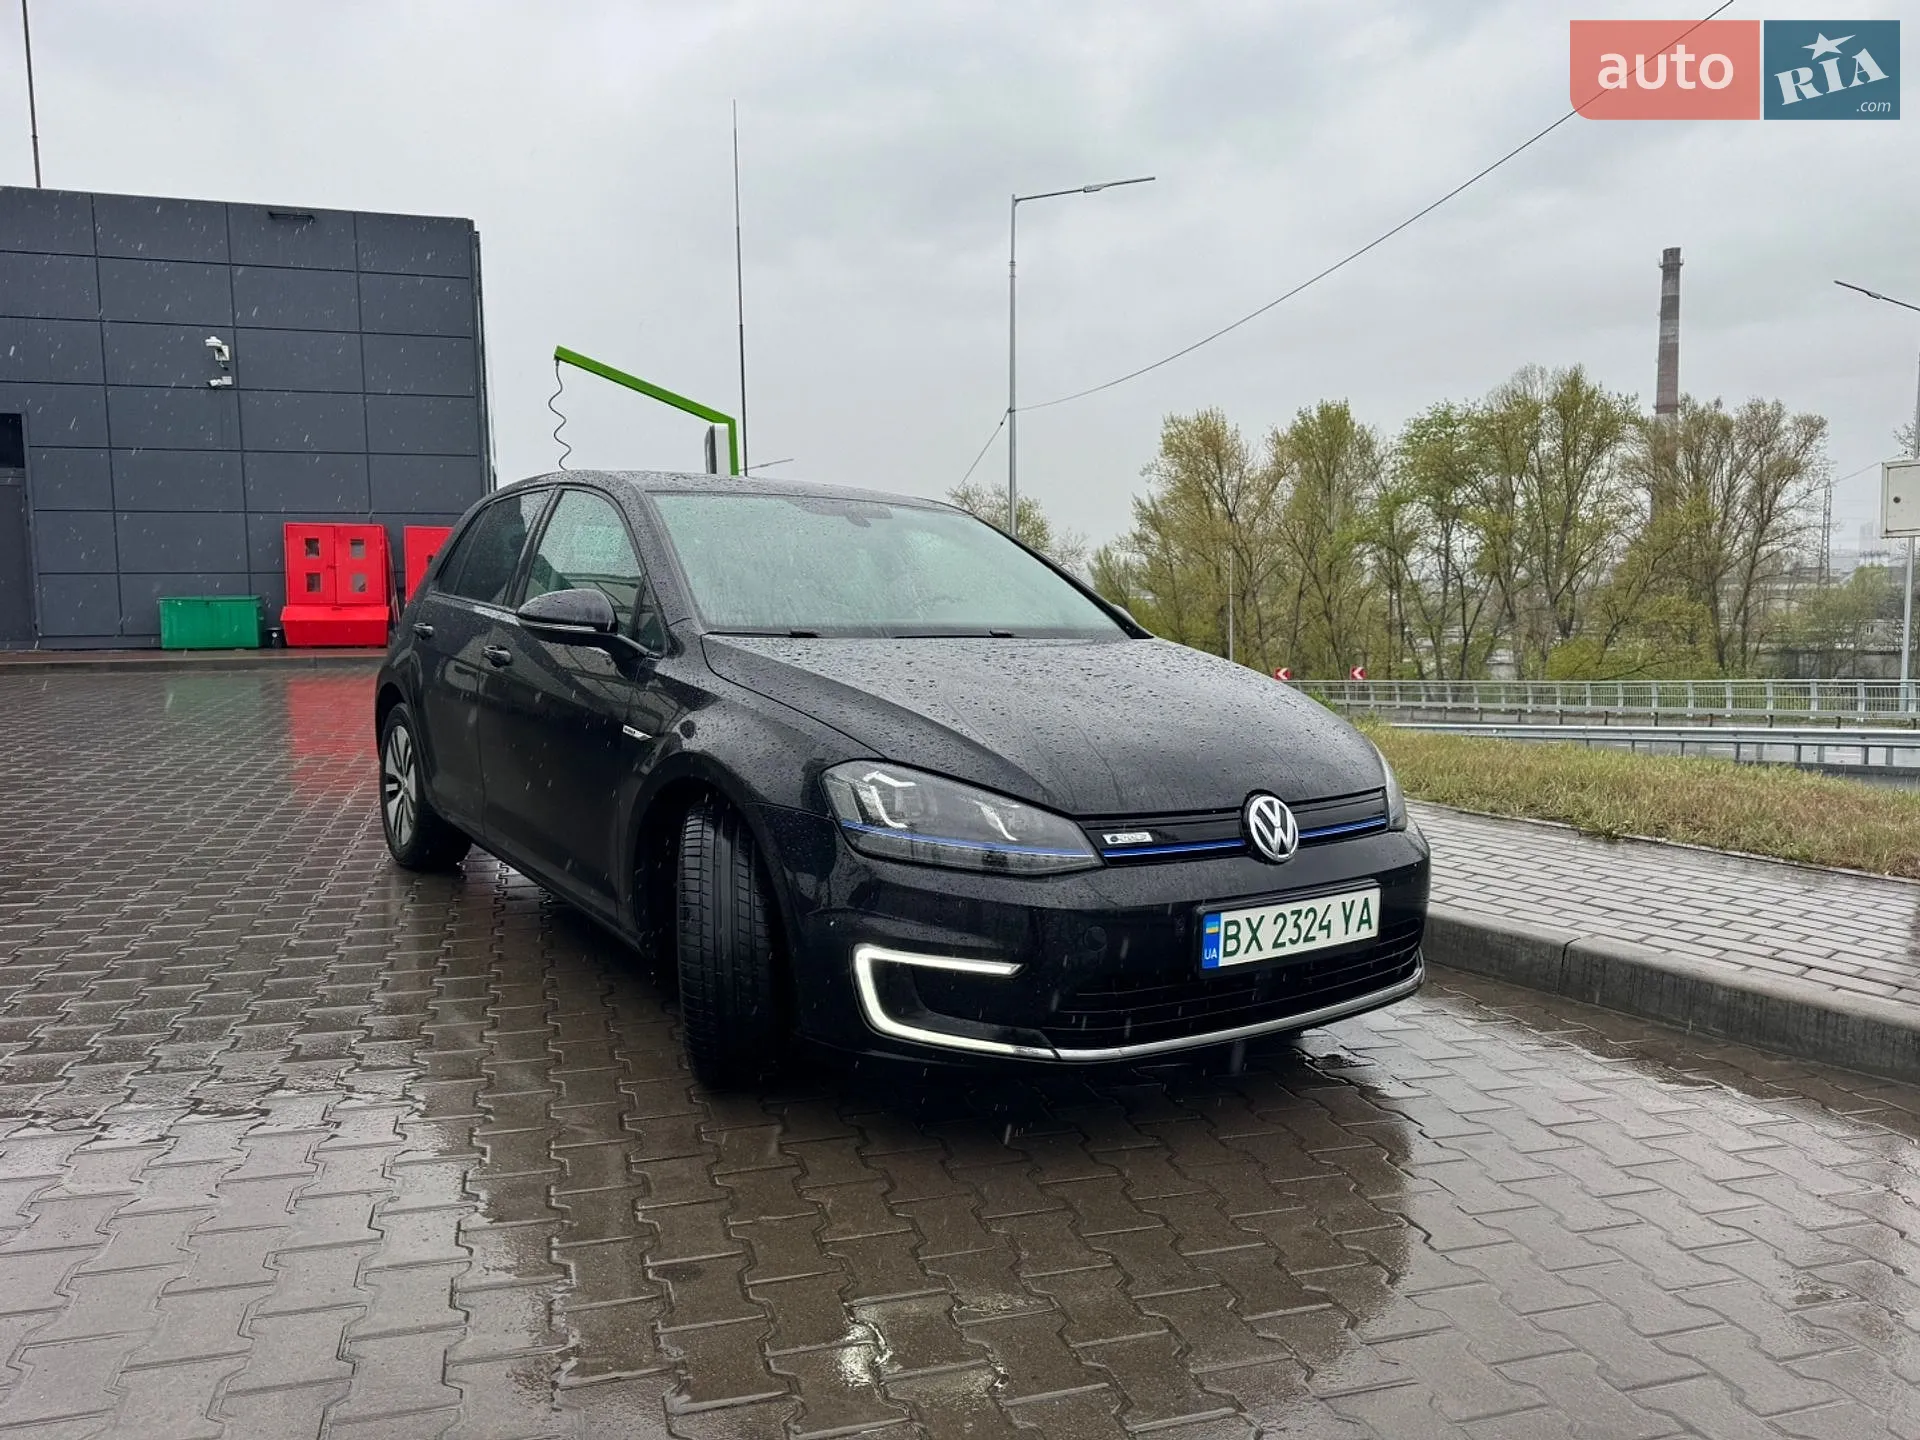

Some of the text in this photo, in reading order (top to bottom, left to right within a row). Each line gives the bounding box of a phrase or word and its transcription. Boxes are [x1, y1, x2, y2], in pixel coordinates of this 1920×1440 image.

[1223, 897, 1373, 957] BX 2324 YA
[1204, 948, 1218, 960] UA
